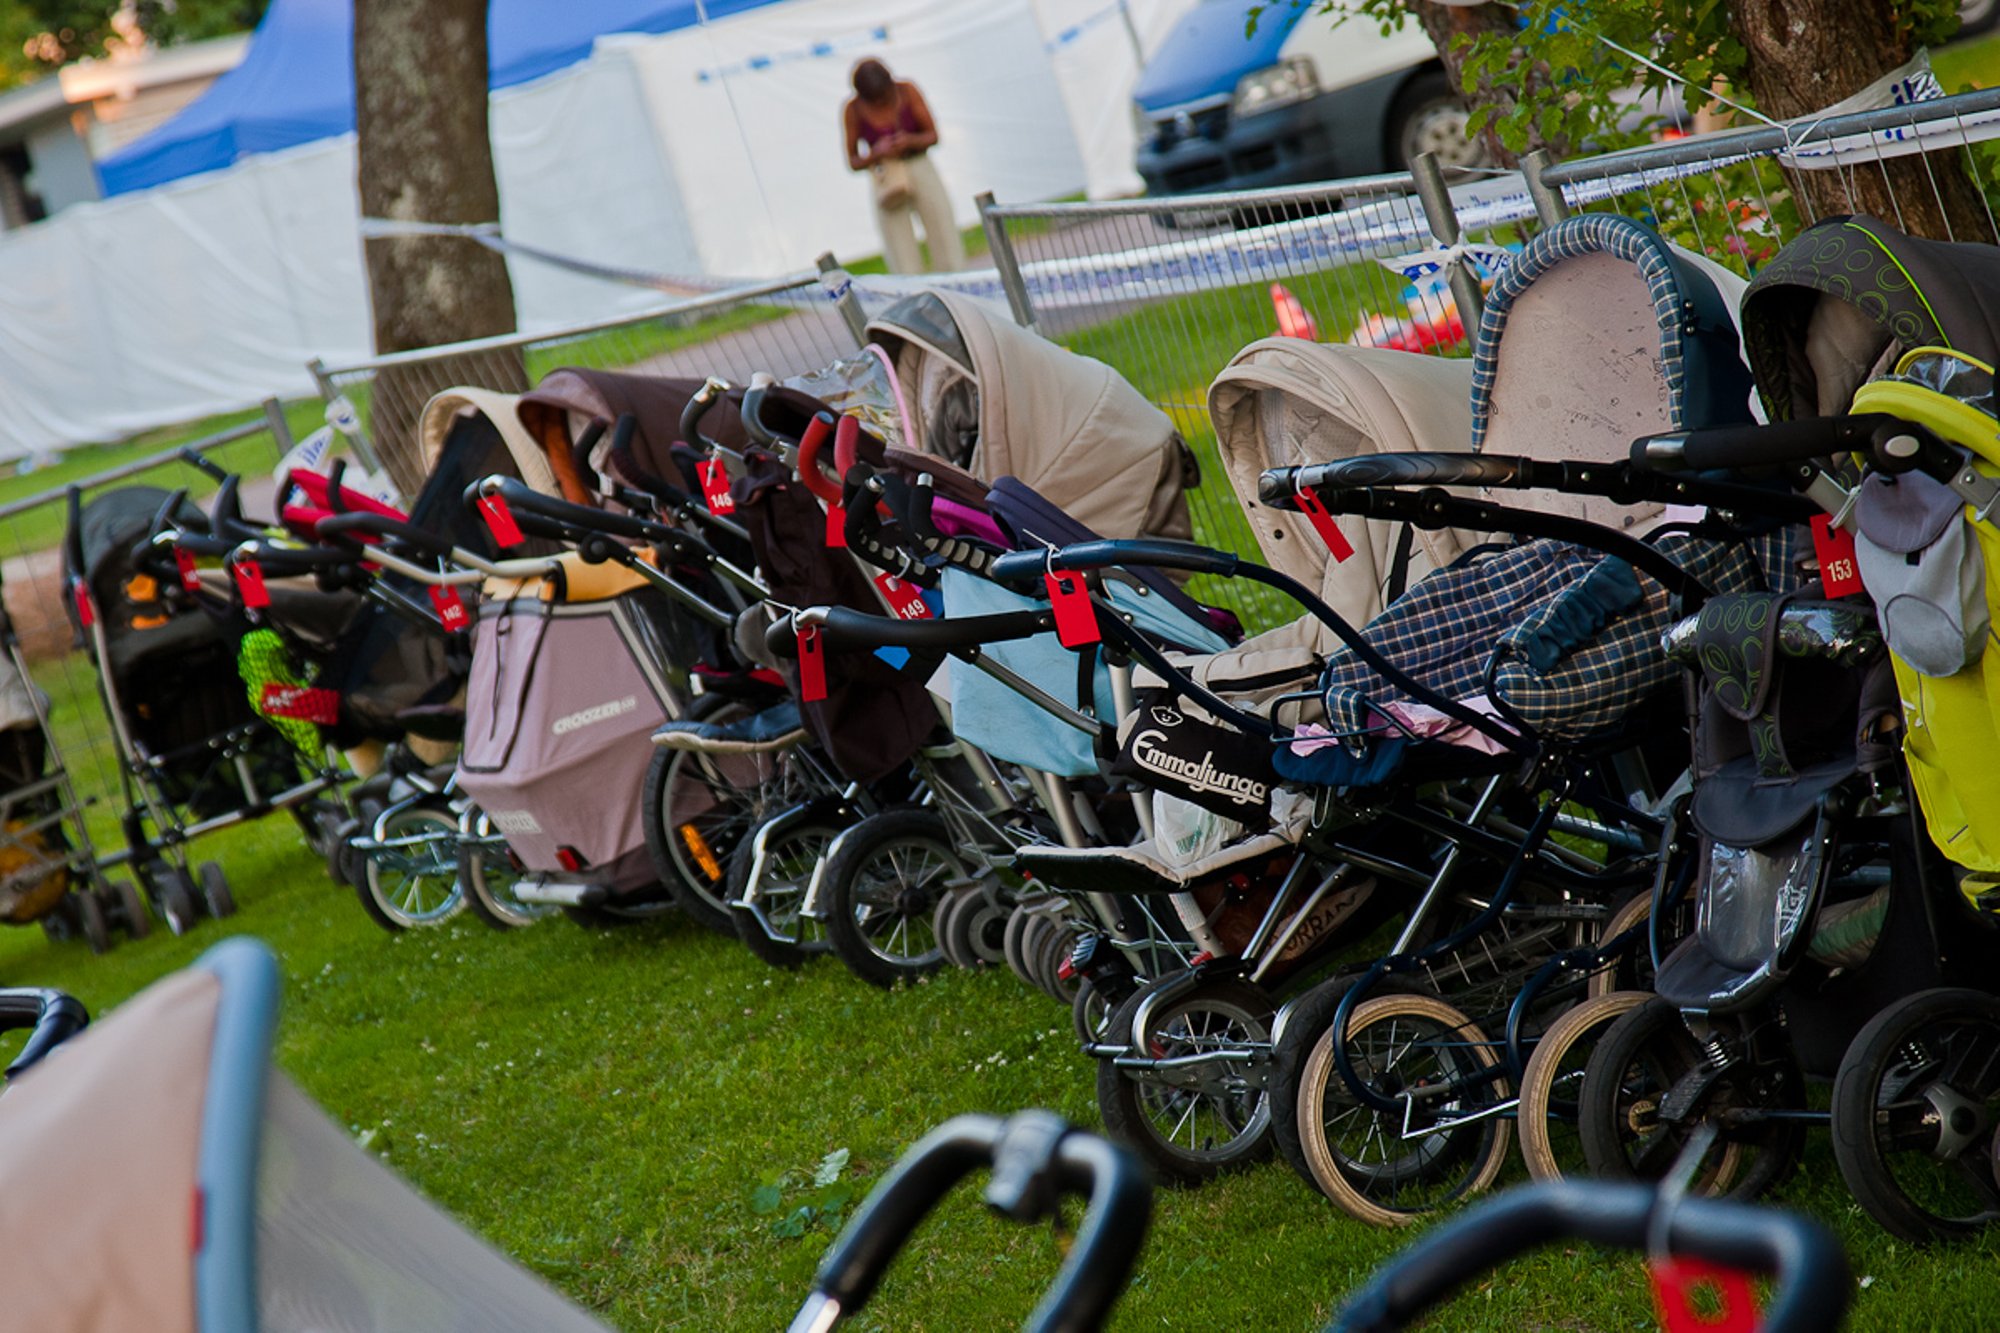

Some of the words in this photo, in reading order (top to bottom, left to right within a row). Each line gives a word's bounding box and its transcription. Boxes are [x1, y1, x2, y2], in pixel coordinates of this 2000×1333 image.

[1827, 558, 1853, 582] 153
[901, 598, 926, 619] 149
[1131, 729, 1268, 805] Emmaljunga
